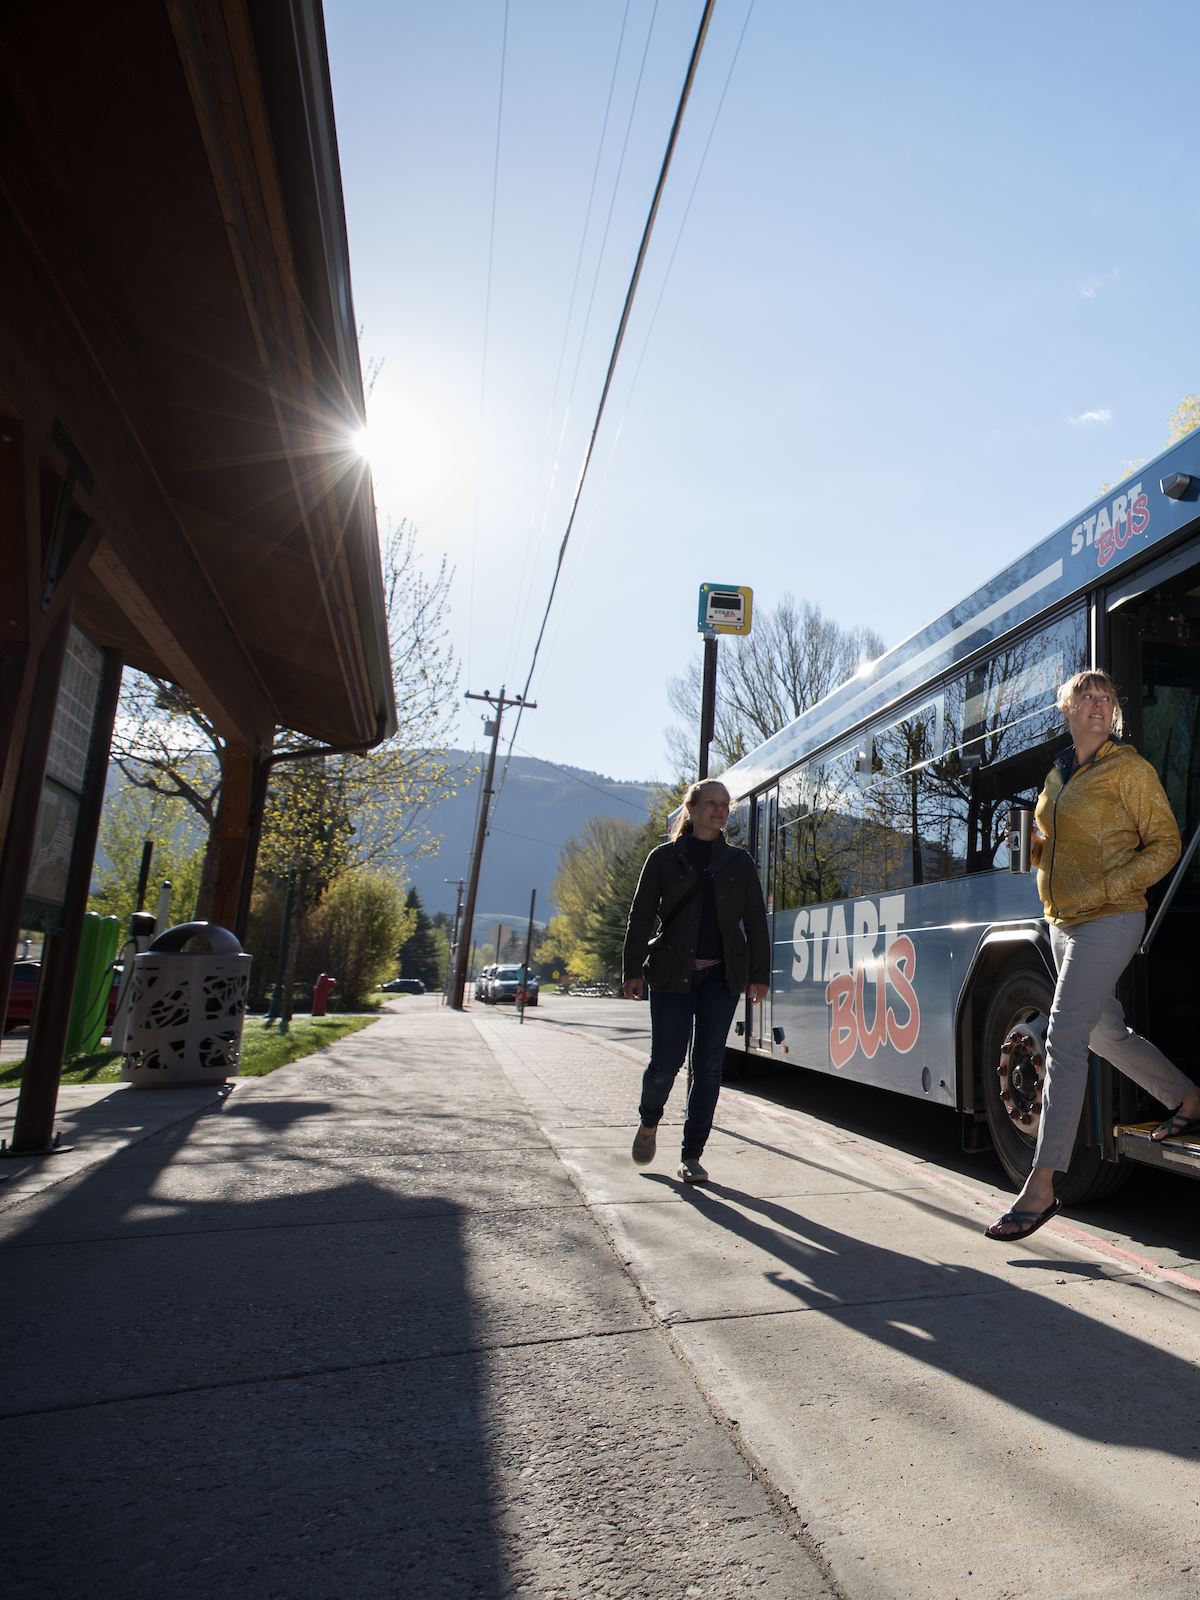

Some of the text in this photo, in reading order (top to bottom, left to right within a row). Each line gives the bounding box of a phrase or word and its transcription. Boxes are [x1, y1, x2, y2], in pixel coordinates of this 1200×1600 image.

[1071, 482, 1142, 556] START
[1095, 493, 1150, 567] BUS
[792, 894, 906, 983] START
[825, 934, 920, 1069] BUS
